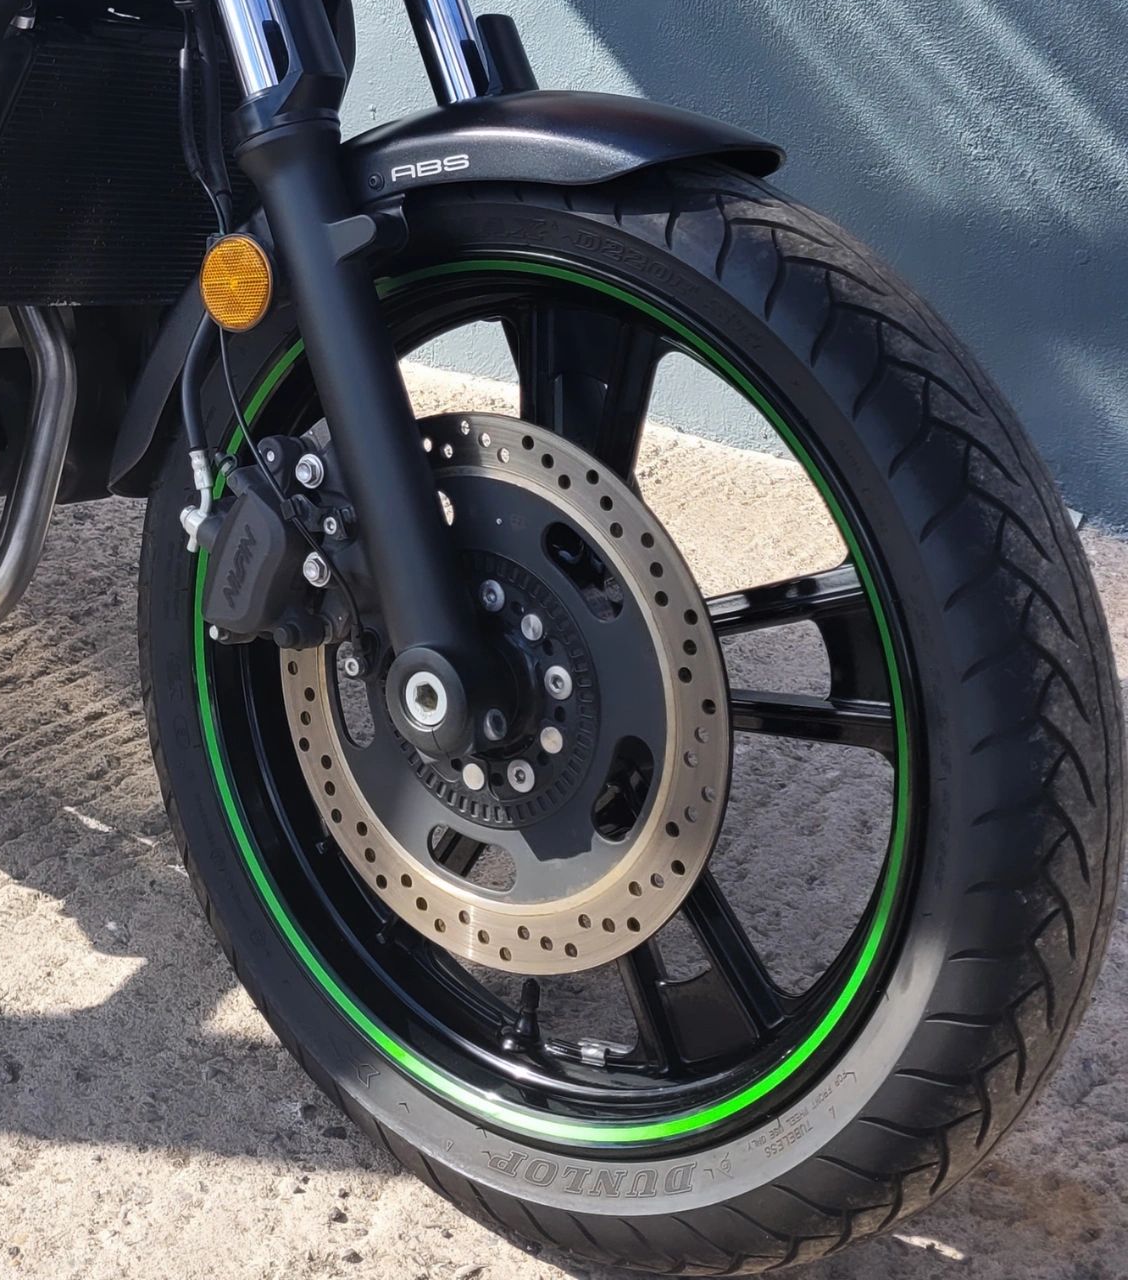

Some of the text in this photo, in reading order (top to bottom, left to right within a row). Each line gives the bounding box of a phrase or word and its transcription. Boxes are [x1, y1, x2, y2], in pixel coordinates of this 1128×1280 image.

[391, 154, 470, 182] ABS
[764, 1120, 813, 1158] TUBELESS
[487, 1150, 698, 1198] DUNLOP
